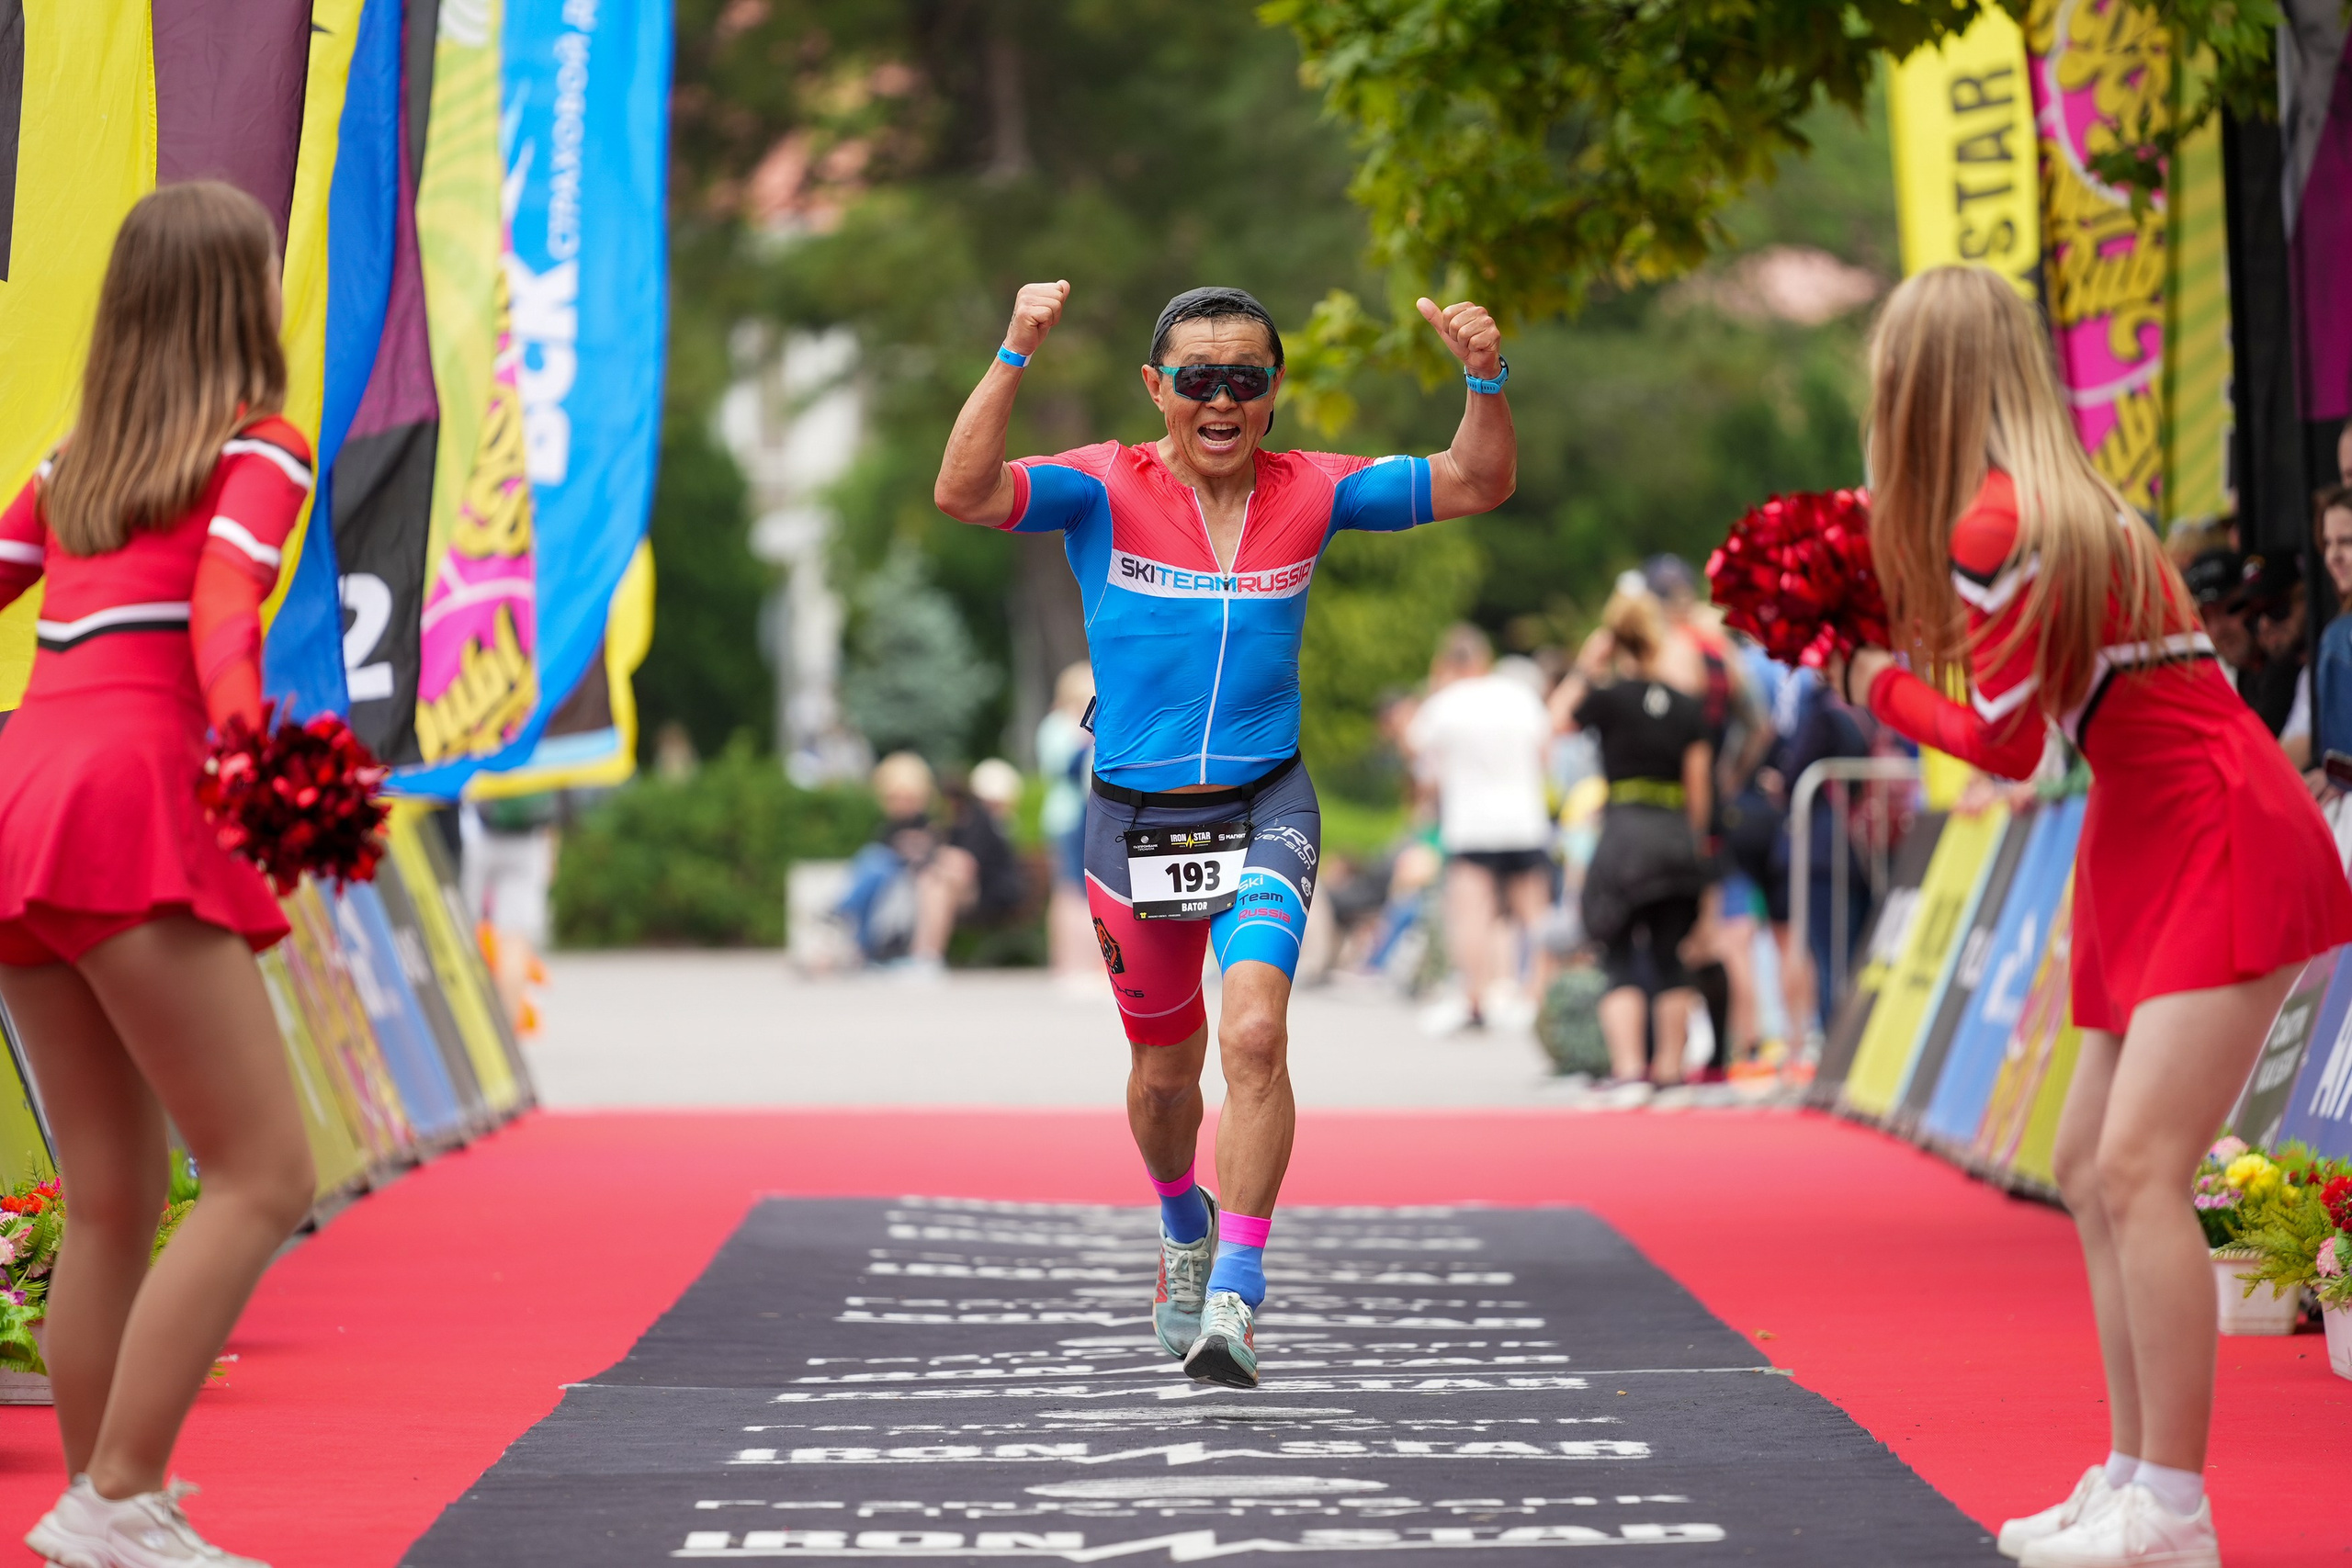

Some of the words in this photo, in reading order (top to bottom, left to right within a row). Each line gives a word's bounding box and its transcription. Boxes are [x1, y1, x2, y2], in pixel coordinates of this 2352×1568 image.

[1951, 61, 2017, 261] STAR
[1170, 833, 1187, 842] IRON
[1193, 831, 1211, 840] STAR
[1165, 860, 1220, 893] 193
[1238, 874, 1264, 894] Ski
[1182, 901, 1207, 912] BATOR
[1239, 892, 1283, 906] Team
[1238, 908, 1291, 923] Russia
[739, 1443, 1088, 1461] IRON
[1280, 1439, 1652, 1457] STAR
[684, 1530, 1085, 1550] IRON
[1301, 1523, 1727, 1544] STAR
